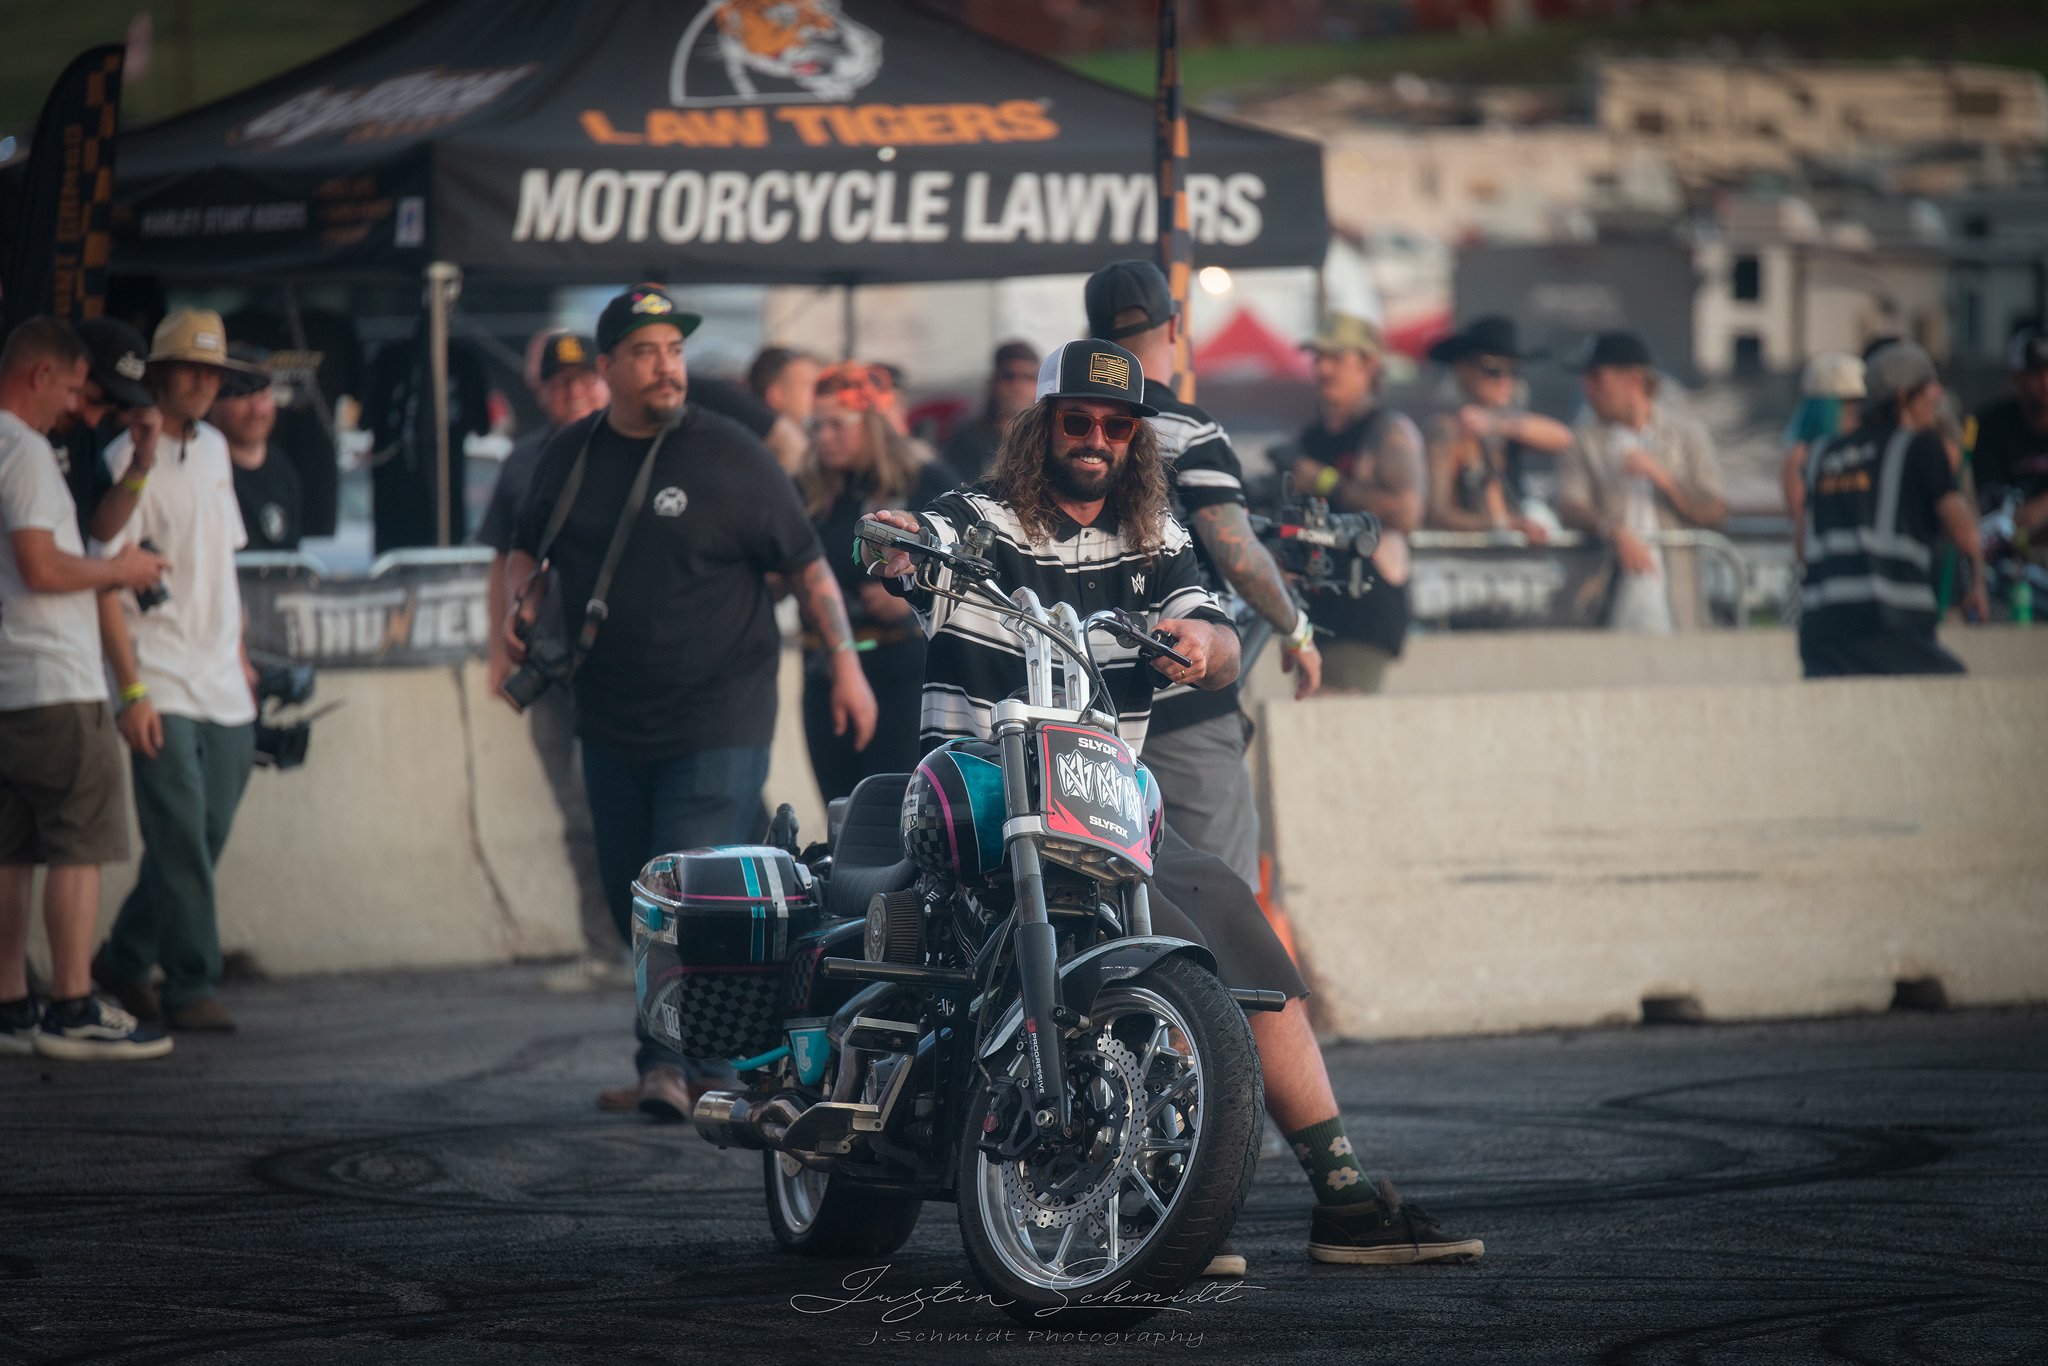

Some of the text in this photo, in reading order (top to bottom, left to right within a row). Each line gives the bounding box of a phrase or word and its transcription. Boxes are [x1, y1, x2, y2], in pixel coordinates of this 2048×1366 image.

[579, 99, 1060, 148] LAW TIGERS
[511, 167, 954, 244] MOTORCYCLE
[1078, 737, 1118, 758] SLYDE
[1089, 815, 1129, 839] SLYFOX
[1031, 1032, 1045, 1094] PROGRESSIVE
